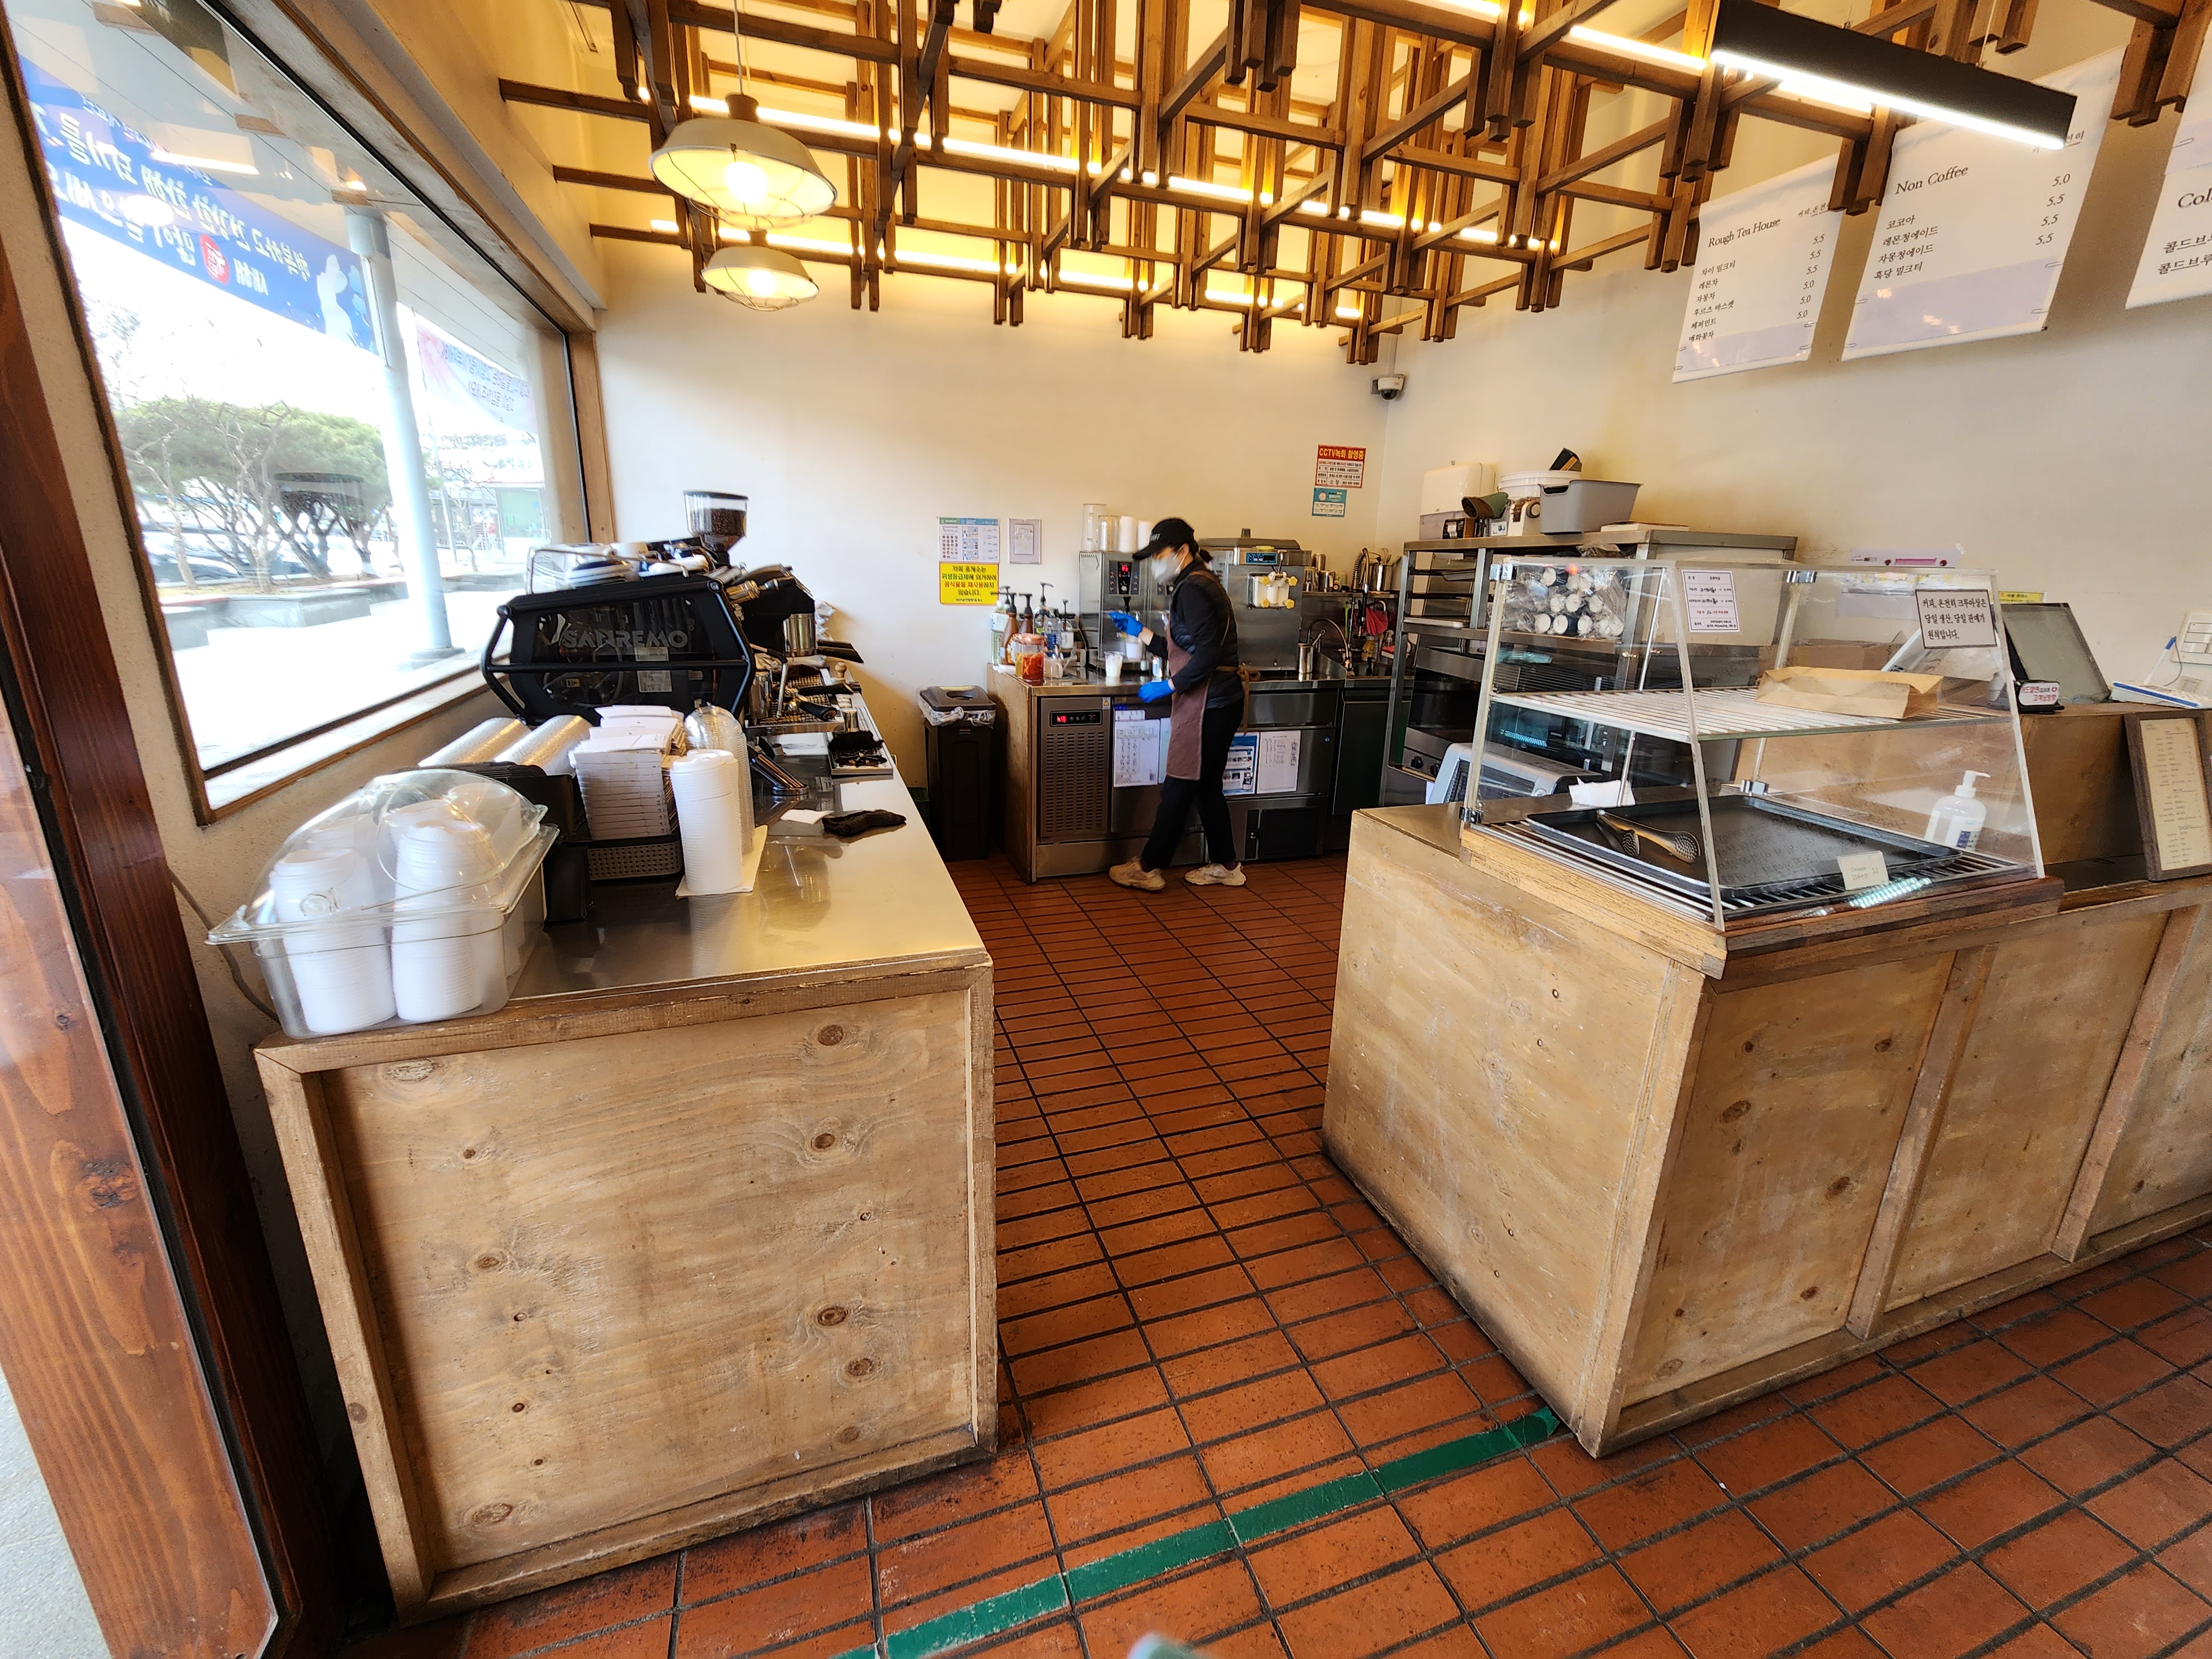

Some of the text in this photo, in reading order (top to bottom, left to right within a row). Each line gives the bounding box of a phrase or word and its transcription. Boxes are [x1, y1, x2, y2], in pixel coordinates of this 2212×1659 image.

[1895, 166, 1969, 194] Non Coffee
[2052, 174, 2070, 186] 5.0
[2047, 194, 2065, 206] 5.5
[2178, 187, 2212, 208] Col
[1886, 215, 1915, 229] 코코아
[2041, 214, 2058, 226] 5.5
[1708, 218, 1781, 248] Rough Tea House
[1813, 234, 1825, 244] 5.5
[1883, 226, 1938, 247] 레몬청에이드
[2036, 233, 2054, 245] 5.5
[1809, 249, 1821, 259] 5.5
[1878, 244, 1933, 263] 자몽청에이드
[1717, 260, 1736, 273] 밀크티
[1807, 264, 1818, 274] 5.5
[1874, 262, 1923, 280] 흑당 밀크티
[1699, 278, 1718, 289] 레몬차
[1803, 280, 1814, 289] 5.0
[1695, 292, 1715, 302] 자몽차
[1800, 295, 1811, 304] 5.0
[1693, 300, 1734, 316] 후르츠 바스켓
[1797, 310, 1808, 319] 5.0
[1689, 331, 1714, 342] 매화꽃차
[1319, 448, 1346, 458] CCTV녹화
[1922, 598, 1987, 608] 커피, 온전히 크루아상은
[1924, 613, 1985, 624] 당일 생산, 당일 판매가
[562, 630, 688, 649] SANREMO
[1927, 629, 1960, 640] 원칙입니다.
